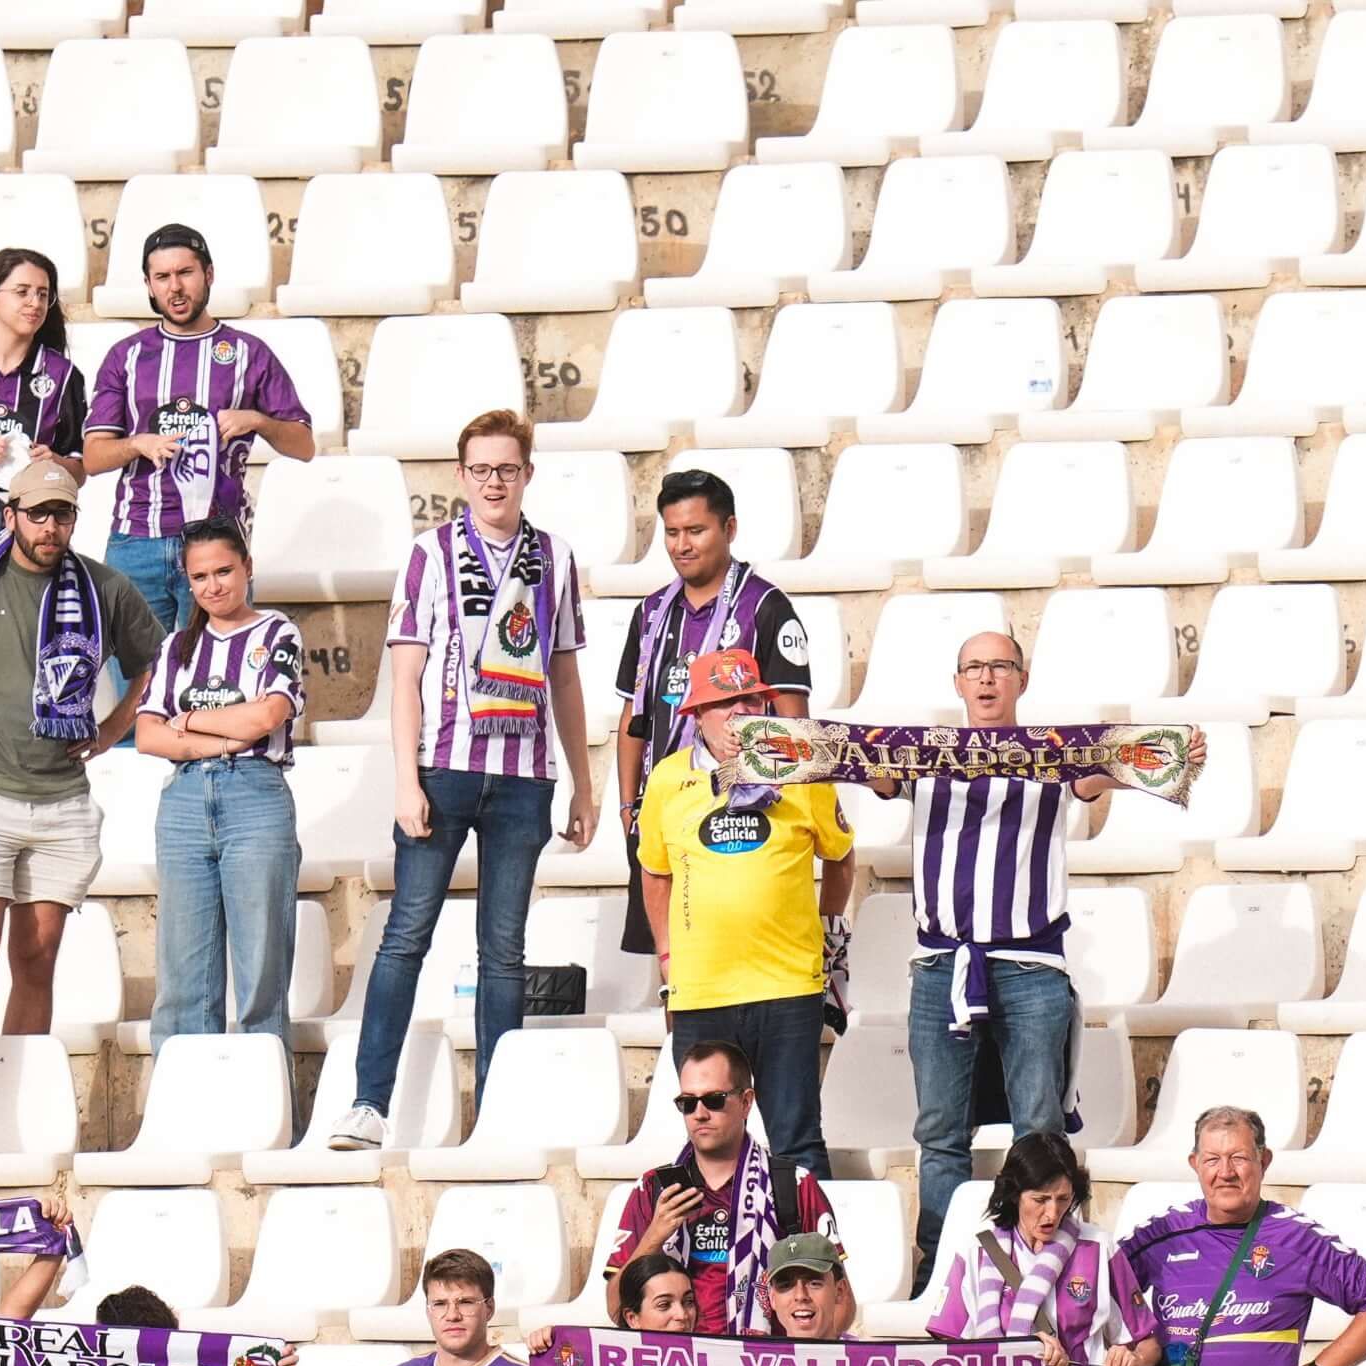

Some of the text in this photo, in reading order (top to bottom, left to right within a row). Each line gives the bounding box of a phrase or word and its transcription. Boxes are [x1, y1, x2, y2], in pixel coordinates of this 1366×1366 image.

[921, 729, 1004, 747] REAL
[811, 737, 1116, 768] VALLADOLID
[710, 816, 759, 829] Estrella
[711, 828, 758, 842] Galicia
[694, 1223, 729, 1238] Estre
[1157, 1293, 1211, 1321] Cuatr
